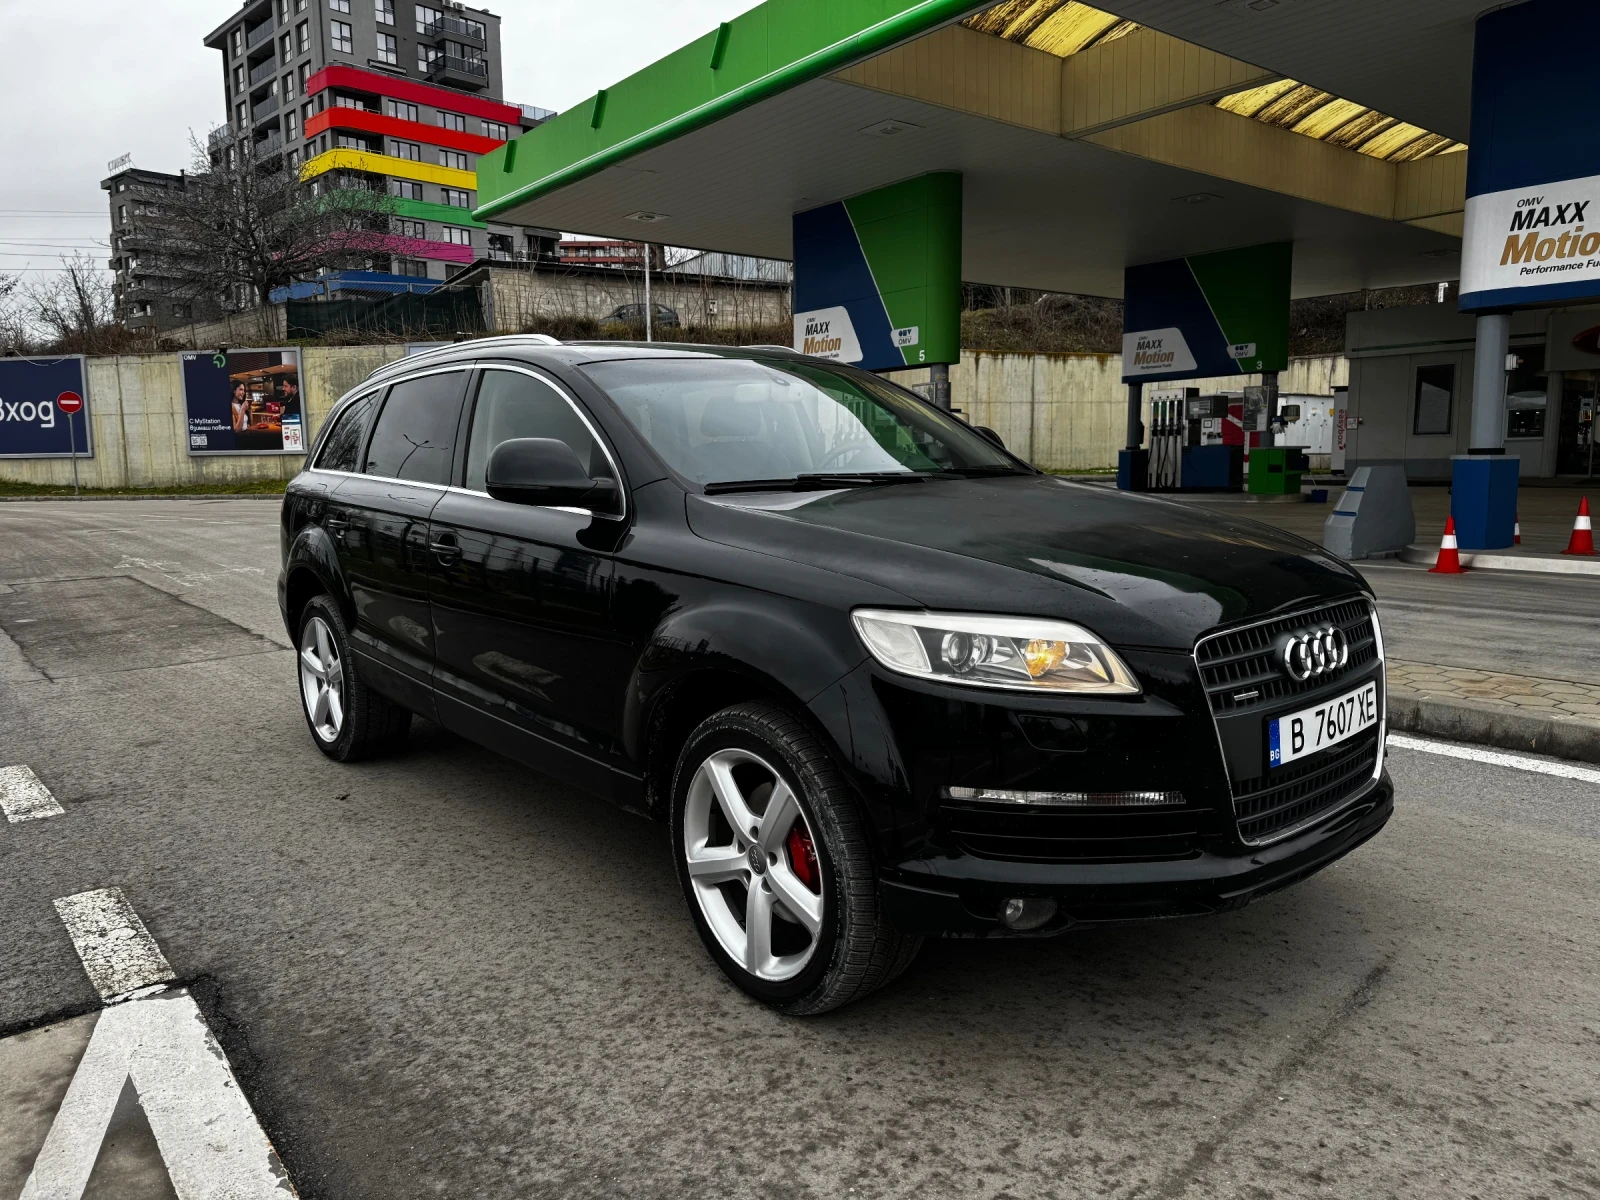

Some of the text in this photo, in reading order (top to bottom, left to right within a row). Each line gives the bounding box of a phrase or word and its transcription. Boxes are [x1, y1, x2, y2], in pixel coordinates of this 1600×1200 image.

[1516, 196, 1544, 208] OMV
[1509, 200, 1591, 232] MAXX
[1499, 225, 1600, 266] Motio
[1519, 262, 1584, 276] Performance
[805, 321, 831, 336] MAXX
[803, 334, 842, 354] Motion
[898, 337, 912, 346] OMV
[1136, 338, 1164, 351] MAXX
[919, 349, 926, 362] 5
[1133, 349, 1175, 366] Motion
[1256, 360, 1263, 370] 3
[1337, 409, 1345, 445] easybox
[1291, 686, 1375, 755] B 7607 XE
[1269, 749, 1280, 761] BG
